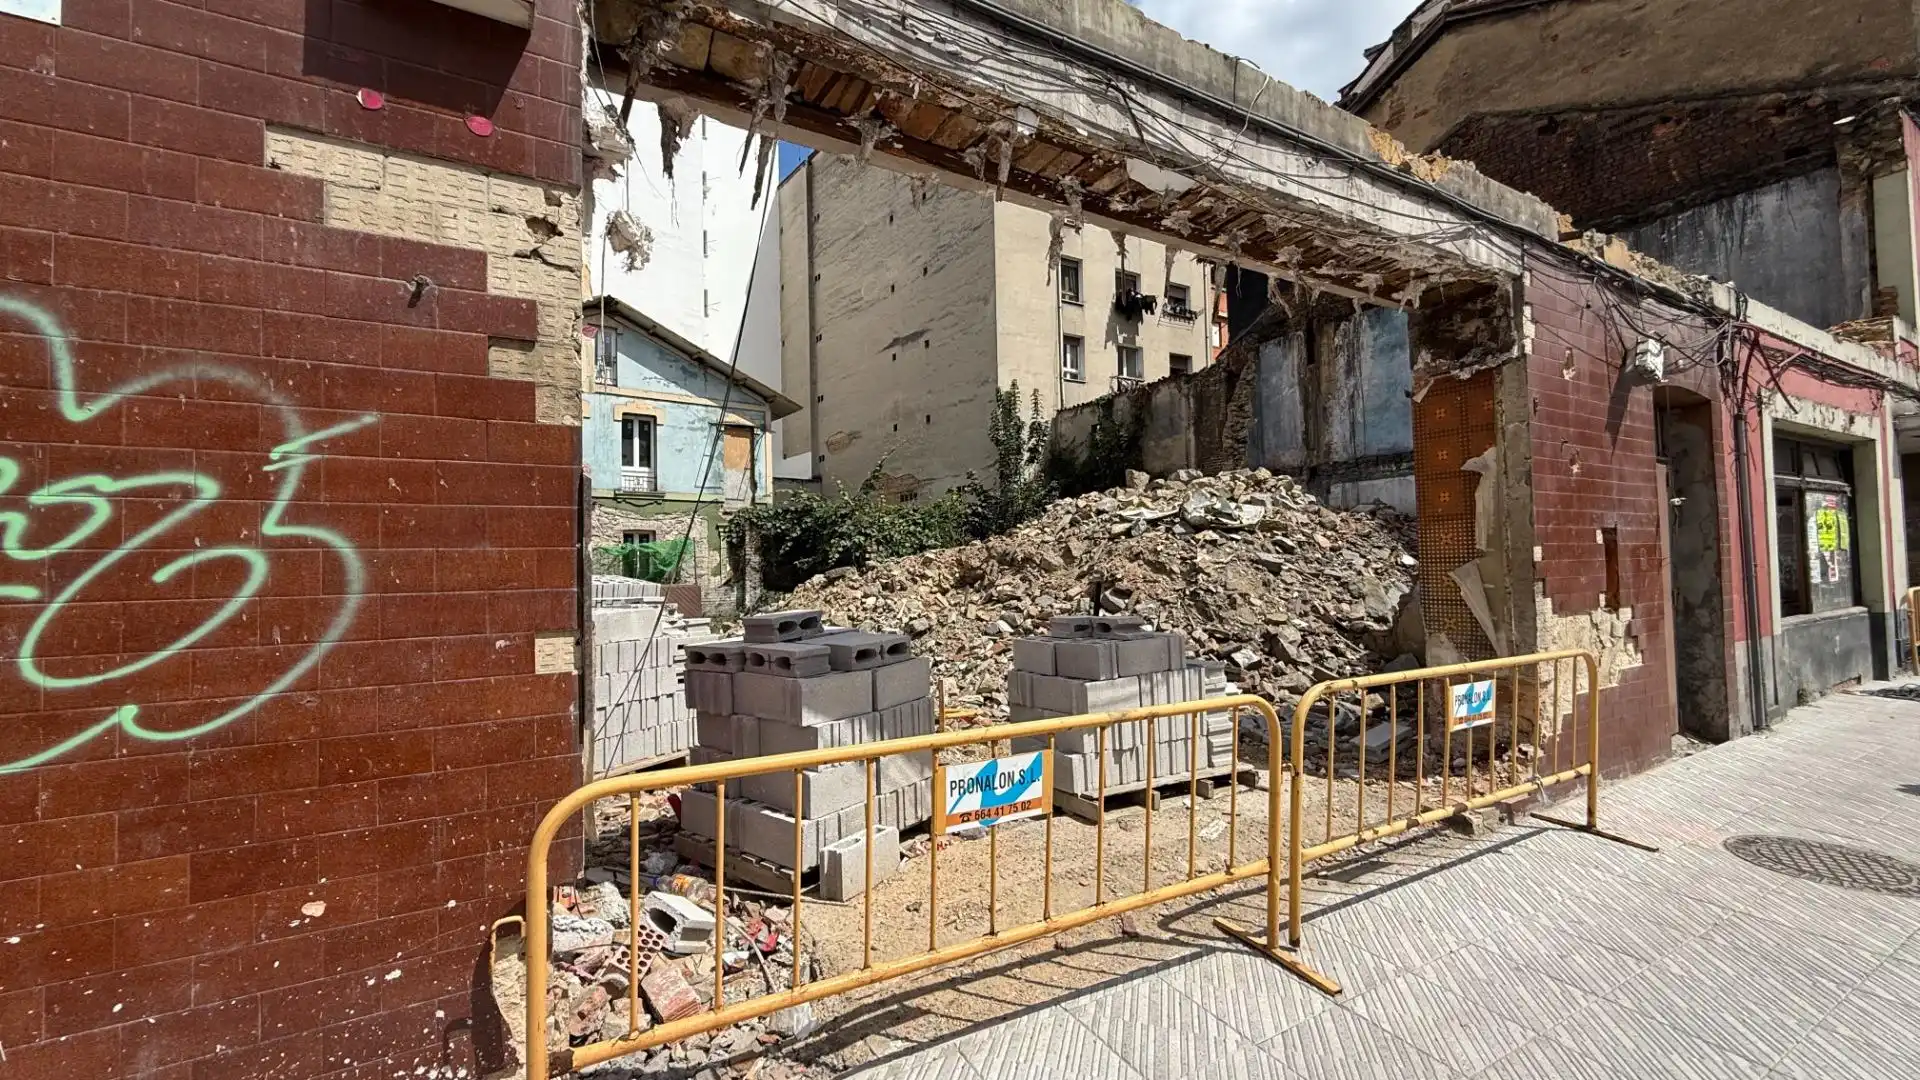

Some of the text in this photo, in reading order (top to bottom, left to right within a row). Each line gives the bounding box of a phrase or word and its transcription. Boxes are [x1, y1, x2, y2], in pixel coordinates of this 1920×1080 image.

[950, 770, 1015, 797] PRONALON
[974, 801, 1032, 820] 664 41 75 02
